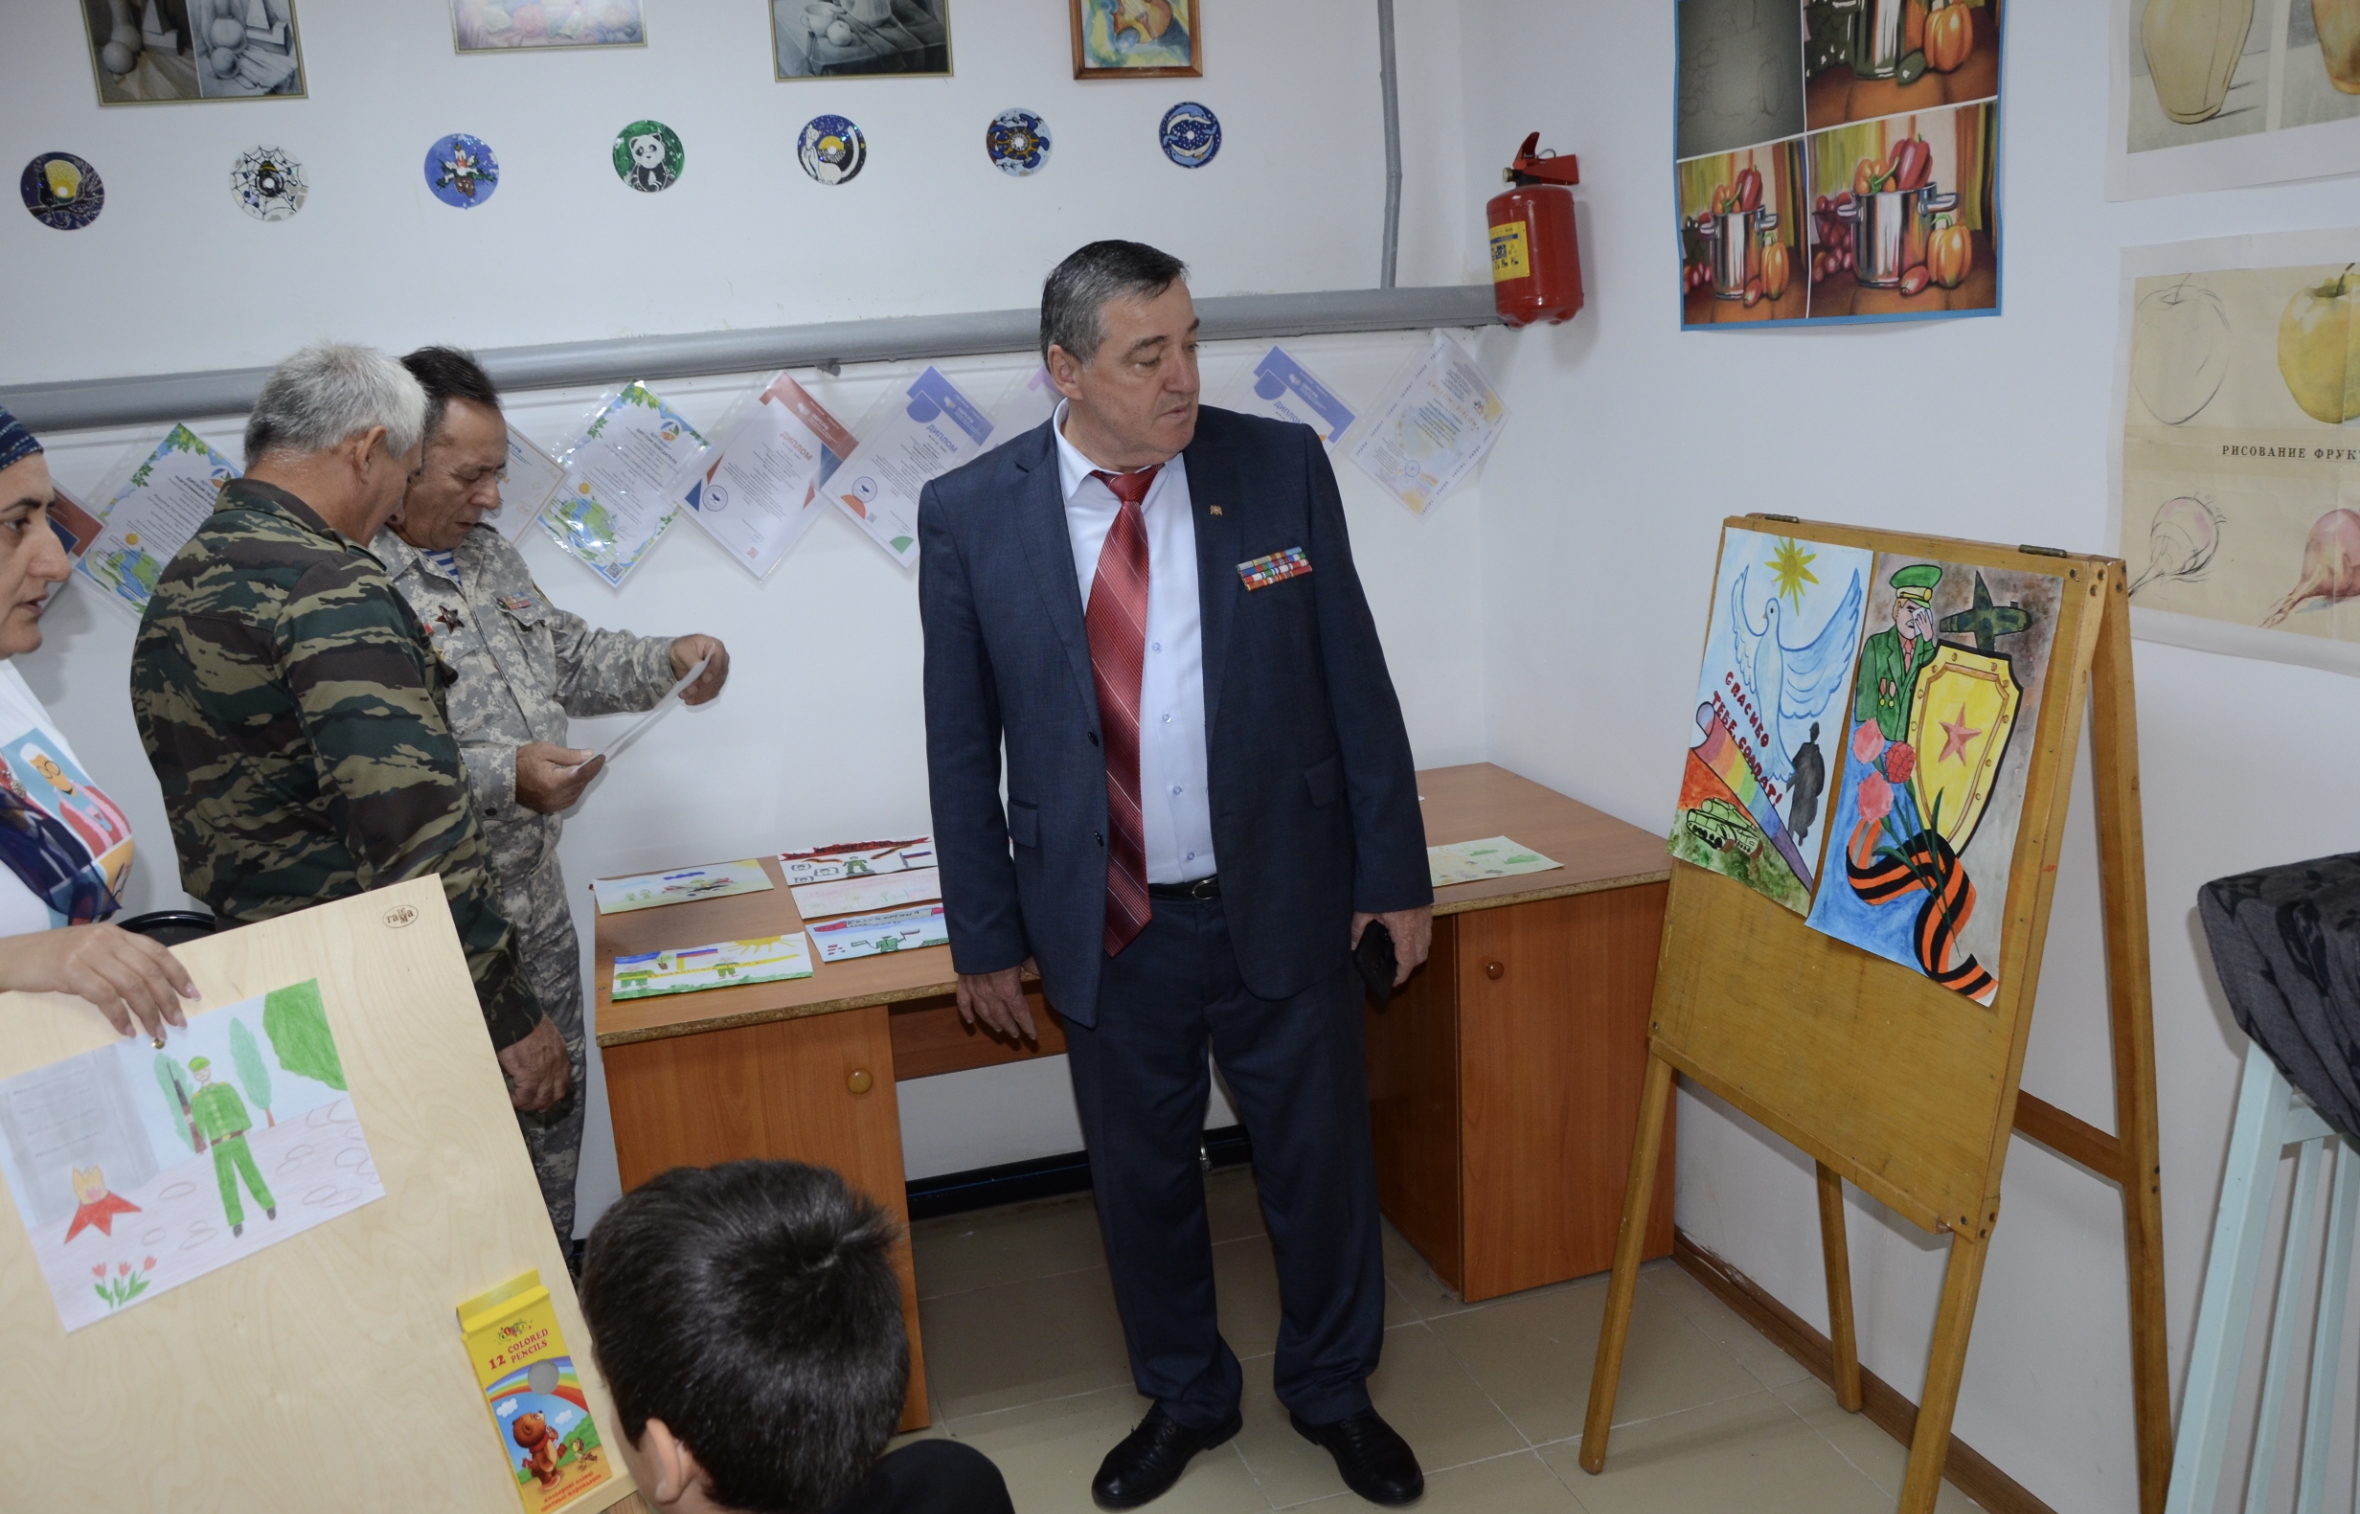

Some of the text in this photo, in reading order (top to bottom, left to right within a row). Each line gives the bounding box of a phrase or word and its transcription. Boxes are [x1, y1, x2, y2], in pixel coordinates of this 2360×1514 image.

[780, 431, 813, 461] ДИПЛОМ
[926, 424, 958, 454] ДИПЛОМ
[2222, 445, 2360, 460] РИСОВАНИЕ ФРУК
[1725, 671, 1769, 747] СПАСИБО
[1712, 690, 1783, 807] ТЕБЕ, СОЛДАТ!
[507, 1328, 548, 1353] COLORED
[511, 1339, 547, 1363] PENCILS
[489, 1354, 506, 1370] 12
